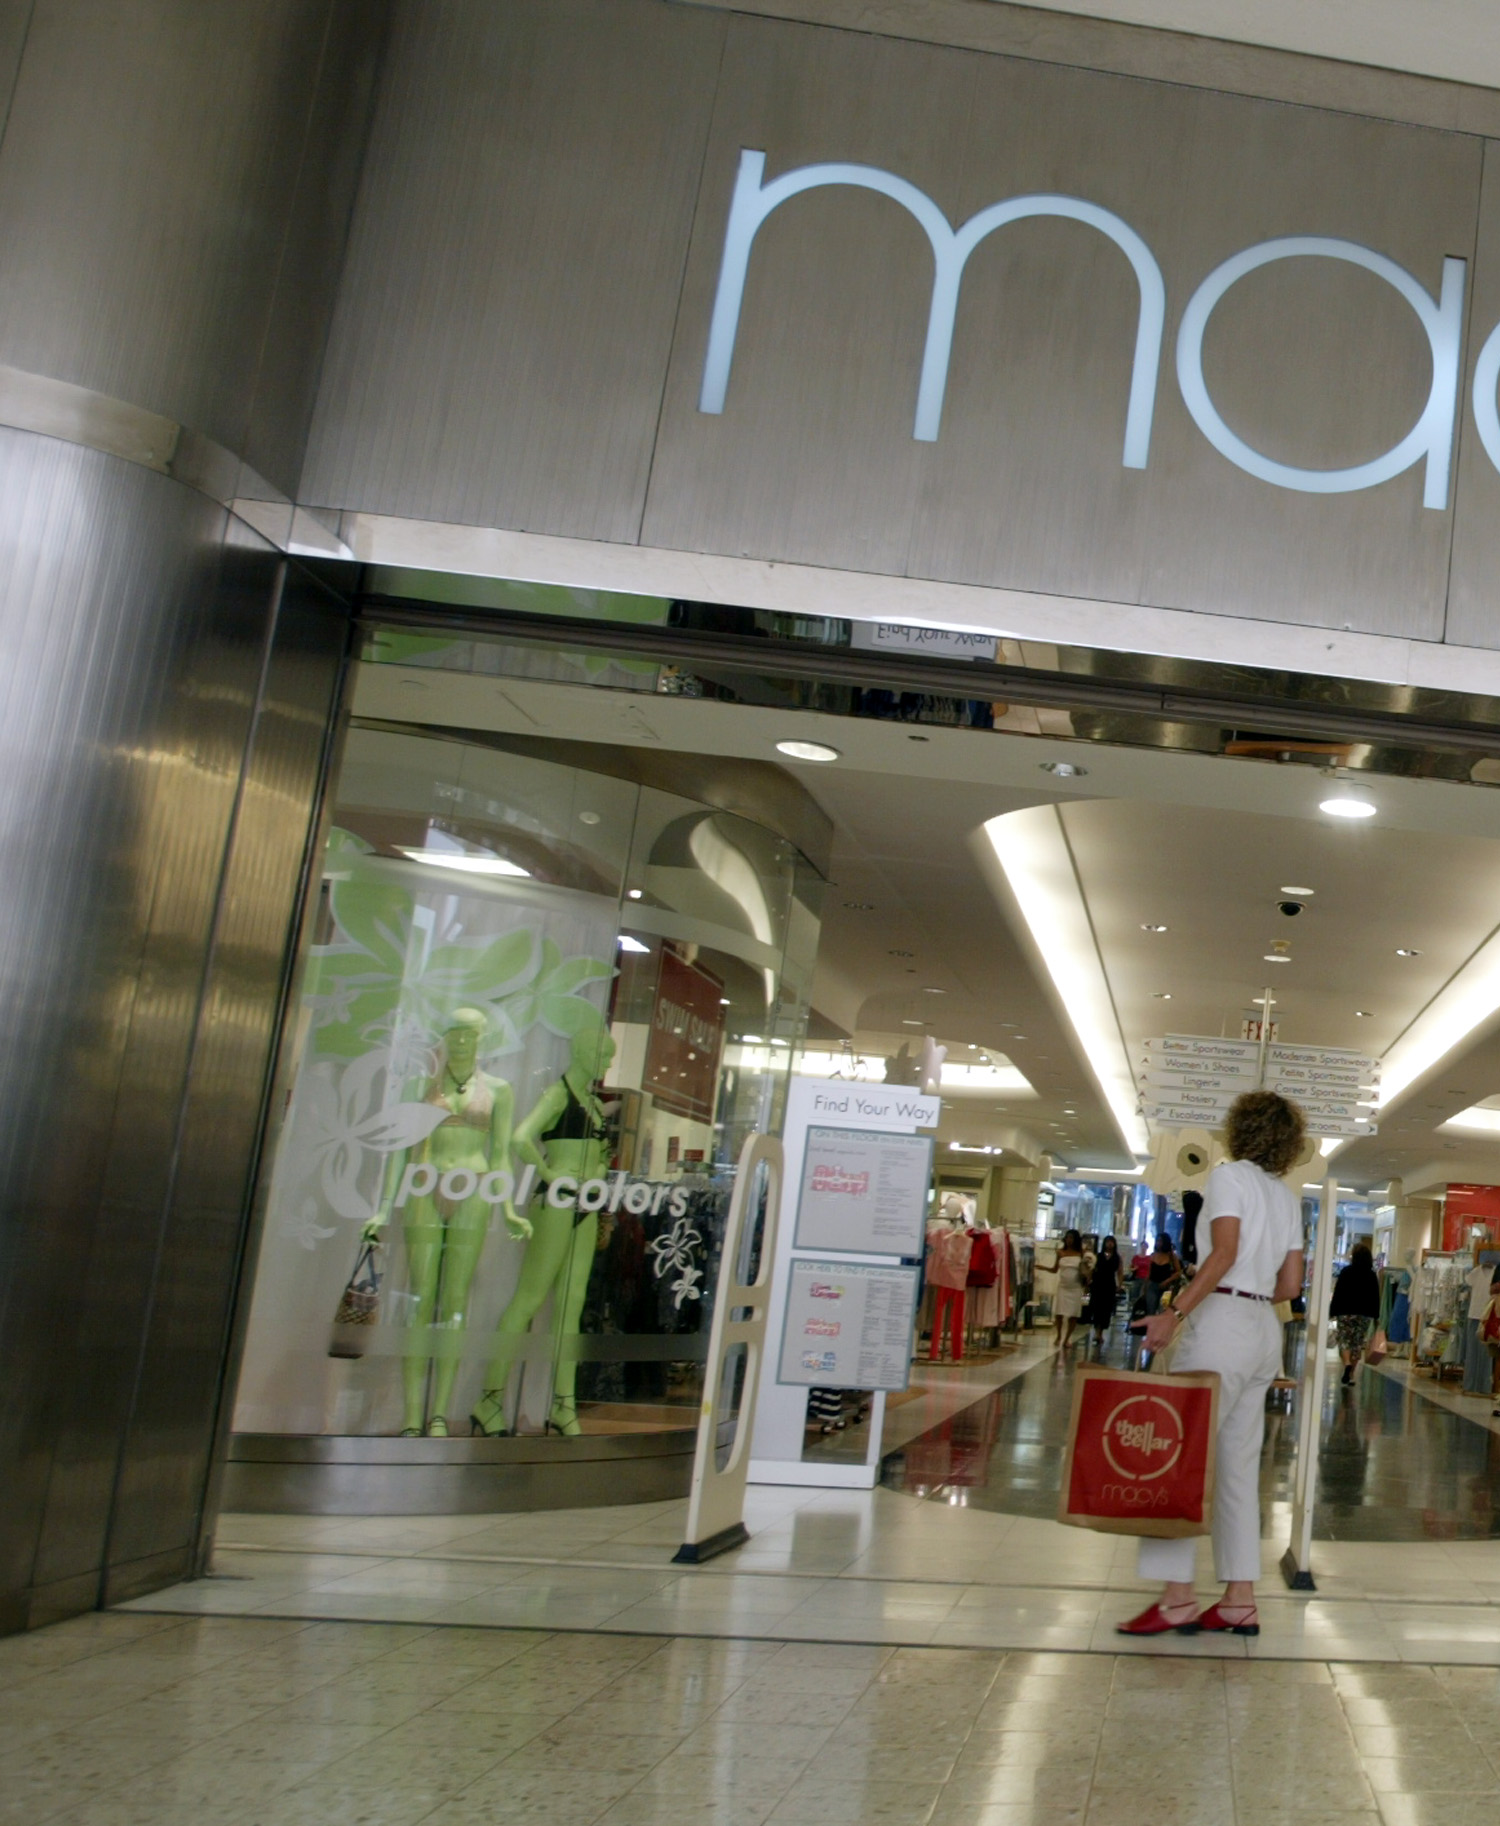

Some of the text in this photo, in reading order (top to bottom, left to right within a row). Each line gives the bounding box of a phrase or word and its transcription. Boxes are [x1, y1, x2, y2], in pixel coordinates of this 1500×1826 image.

[1247, 1021, 1275, 1042] EXT
[1192, 1042, 1246, 1056] Sportswear
[1165, 1057, 1241, 1073] Women's Shoes
[1272, 1050, 1371, 1067] Moderate Sportswear
[1183, 1075, 1221, 1089] Lingerie
[1280, 1066, 1360, 1082] Petite Sportswear
[1181, 1092, 1217, 1106] Hosiery
[1275, 1083, 1362, 1099] Career Sportswear
[813, 1094, 935, 1124] Find Your Way
[1169, 1109, 1217, 1121] Escalators
[394, 1162, 690, 1217] pool colors
[1120, 1421, 1173, 1457] cellar
